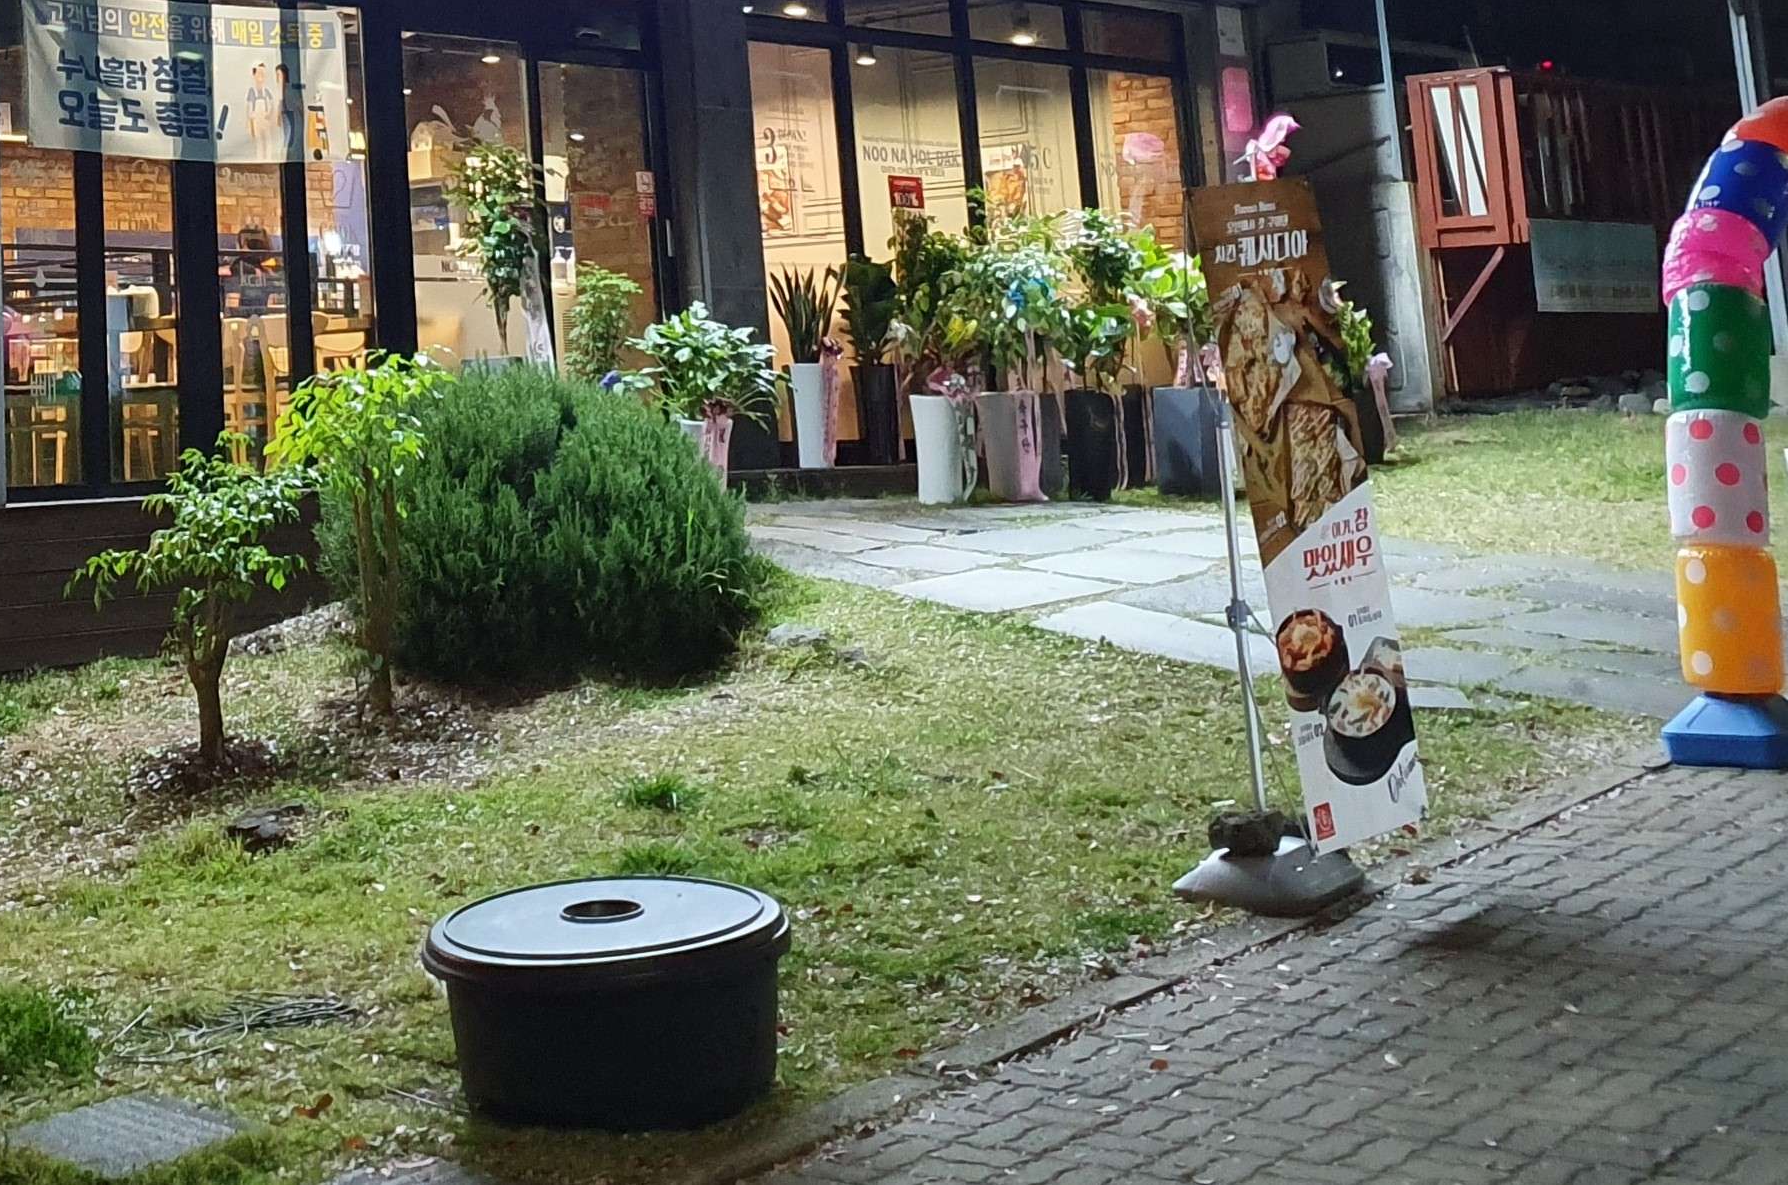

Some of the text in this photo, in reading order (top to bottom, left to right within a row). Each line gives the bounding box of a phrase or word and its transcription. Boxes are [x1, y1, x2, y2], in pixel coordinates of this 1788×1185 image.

[46, 0, 123, 36] 고객님의
[129, 10, 185, 41] 안전을
[191, 15, 226, 44] 위해
[231, 19, 265, 46] 매일
[306, 22, 325, 49] 중
[56, 49, 148, 92] 누나홀닭
[58, 89, 149, 134] 오늘도
